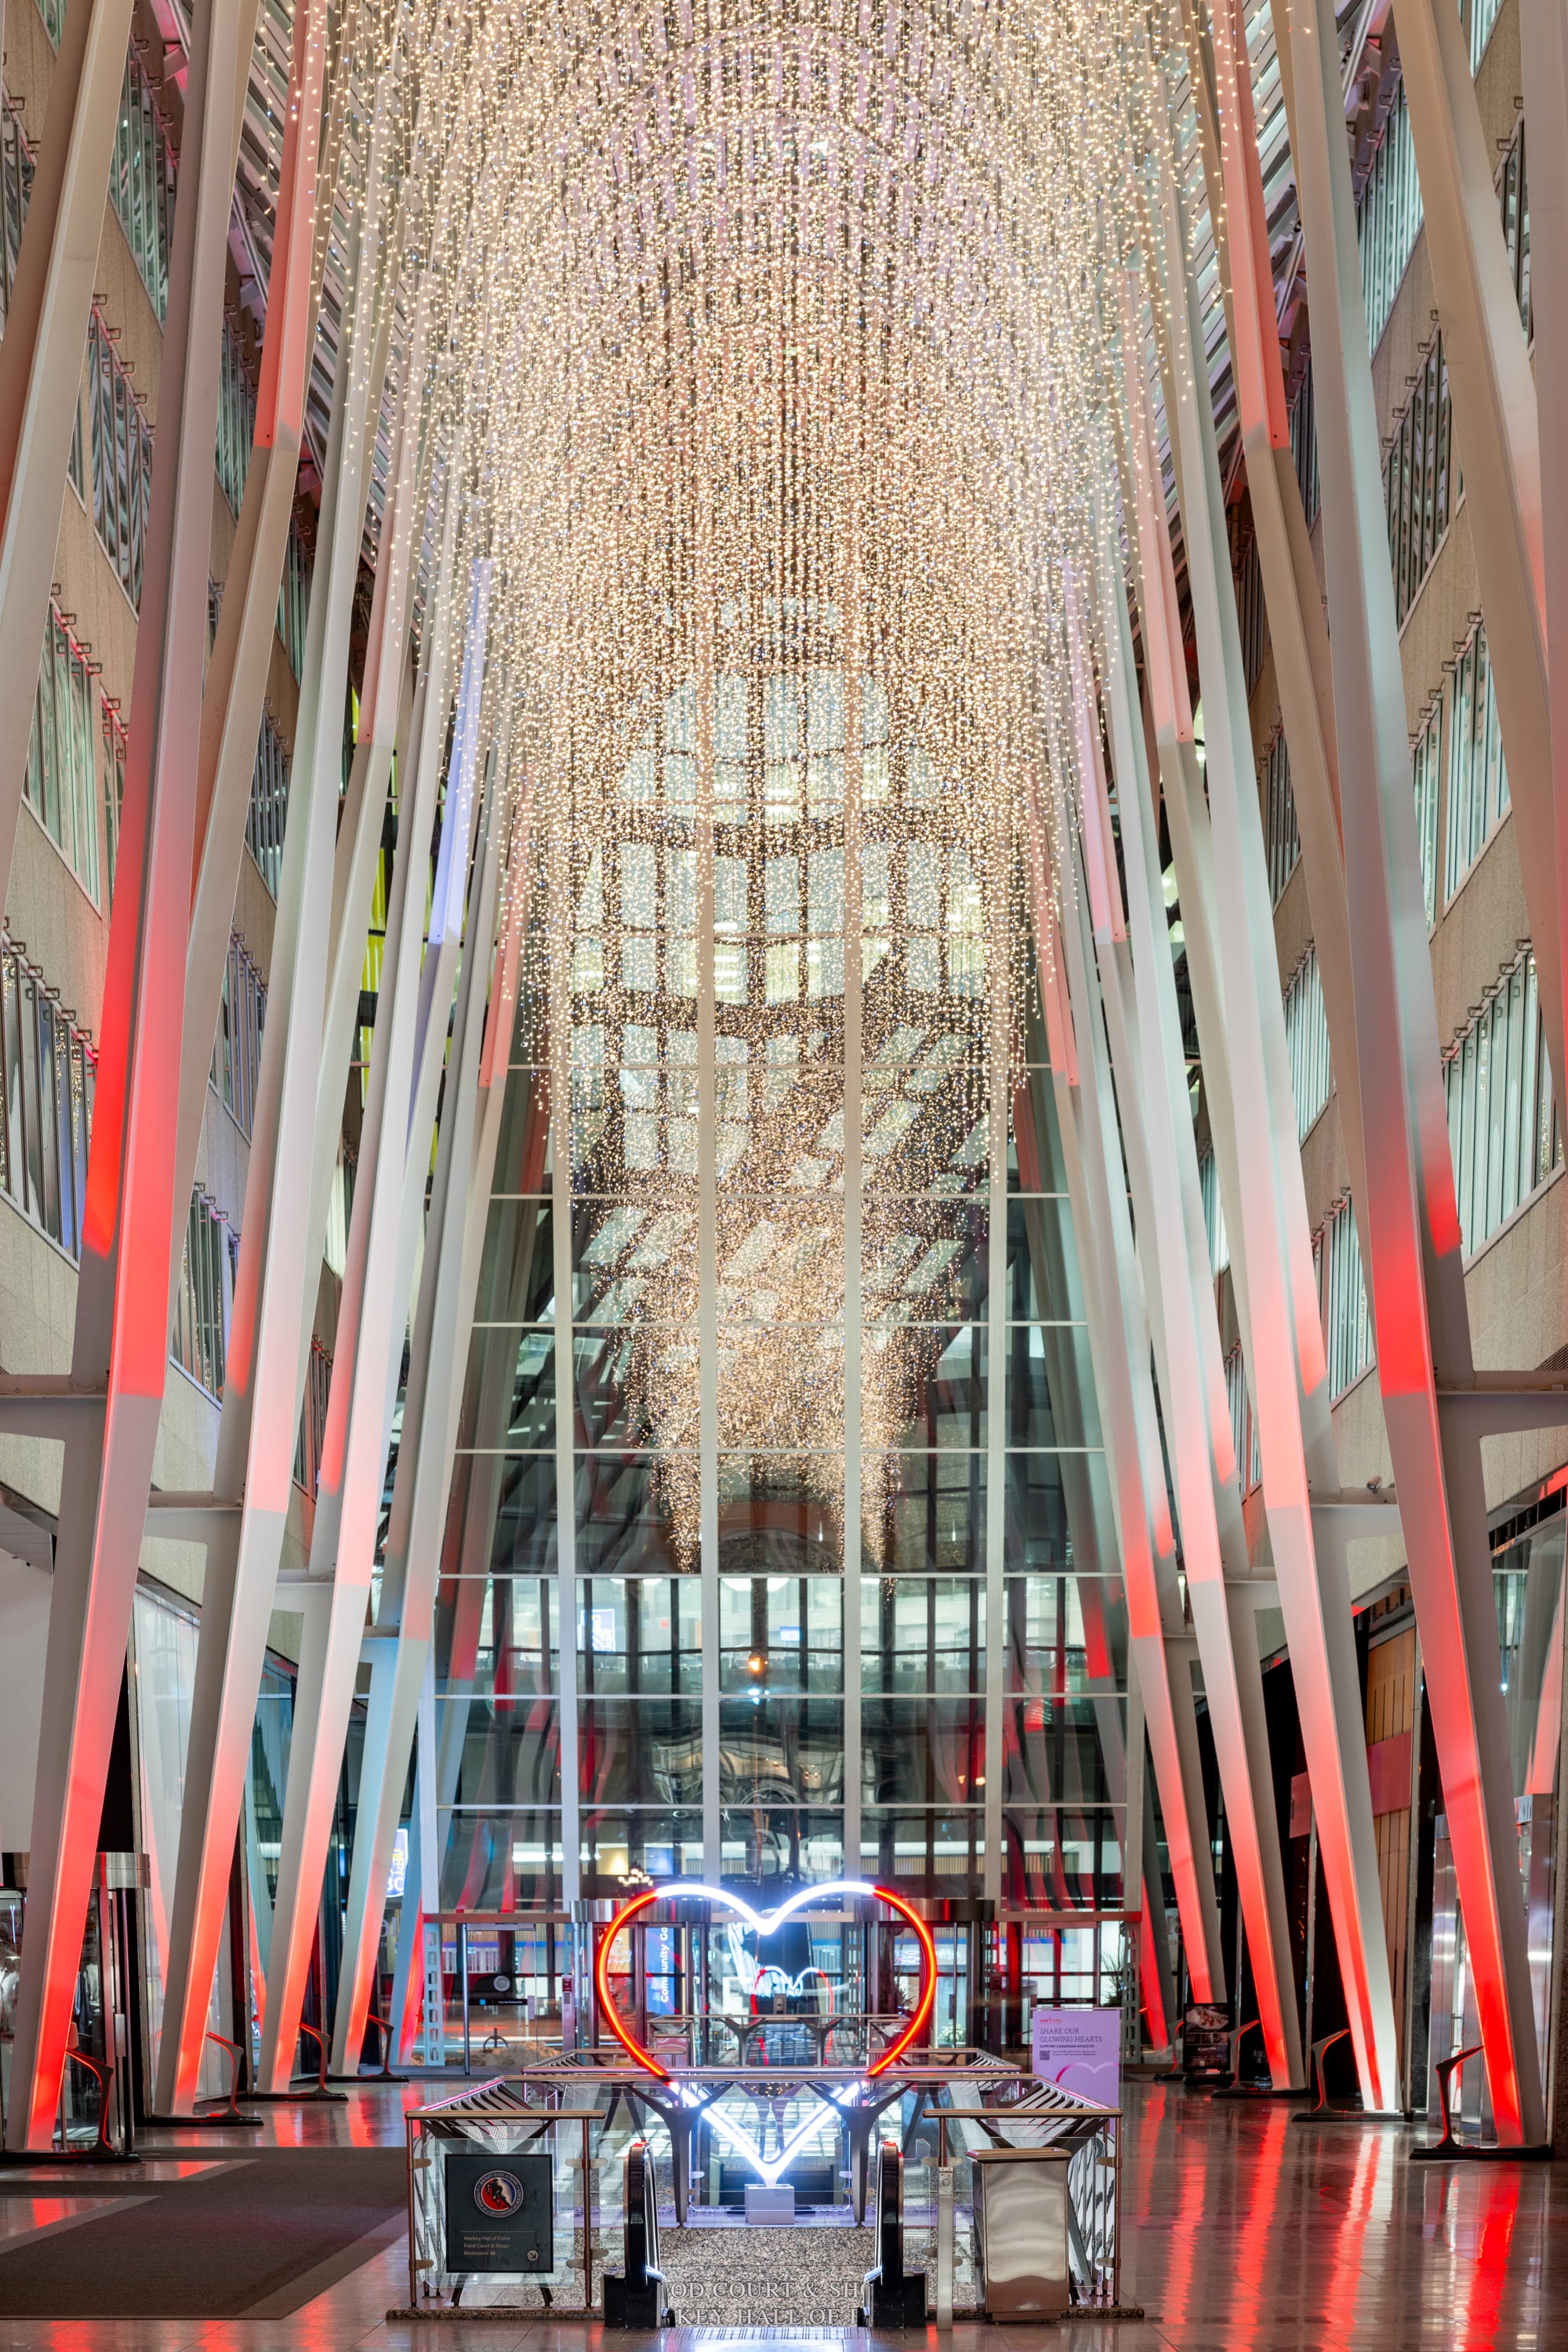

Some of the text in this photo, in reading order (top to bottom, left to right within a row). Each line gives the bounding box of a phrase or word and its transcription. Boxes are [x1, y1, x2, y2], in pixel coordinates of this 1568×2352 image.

[670, 2281, 864, 2298] OD COURT & SH
[677, 2309, 727, 2325] KEY
[738, 2309, 801, 2325] HALL
[809, 2308, 840, 2325] OF
